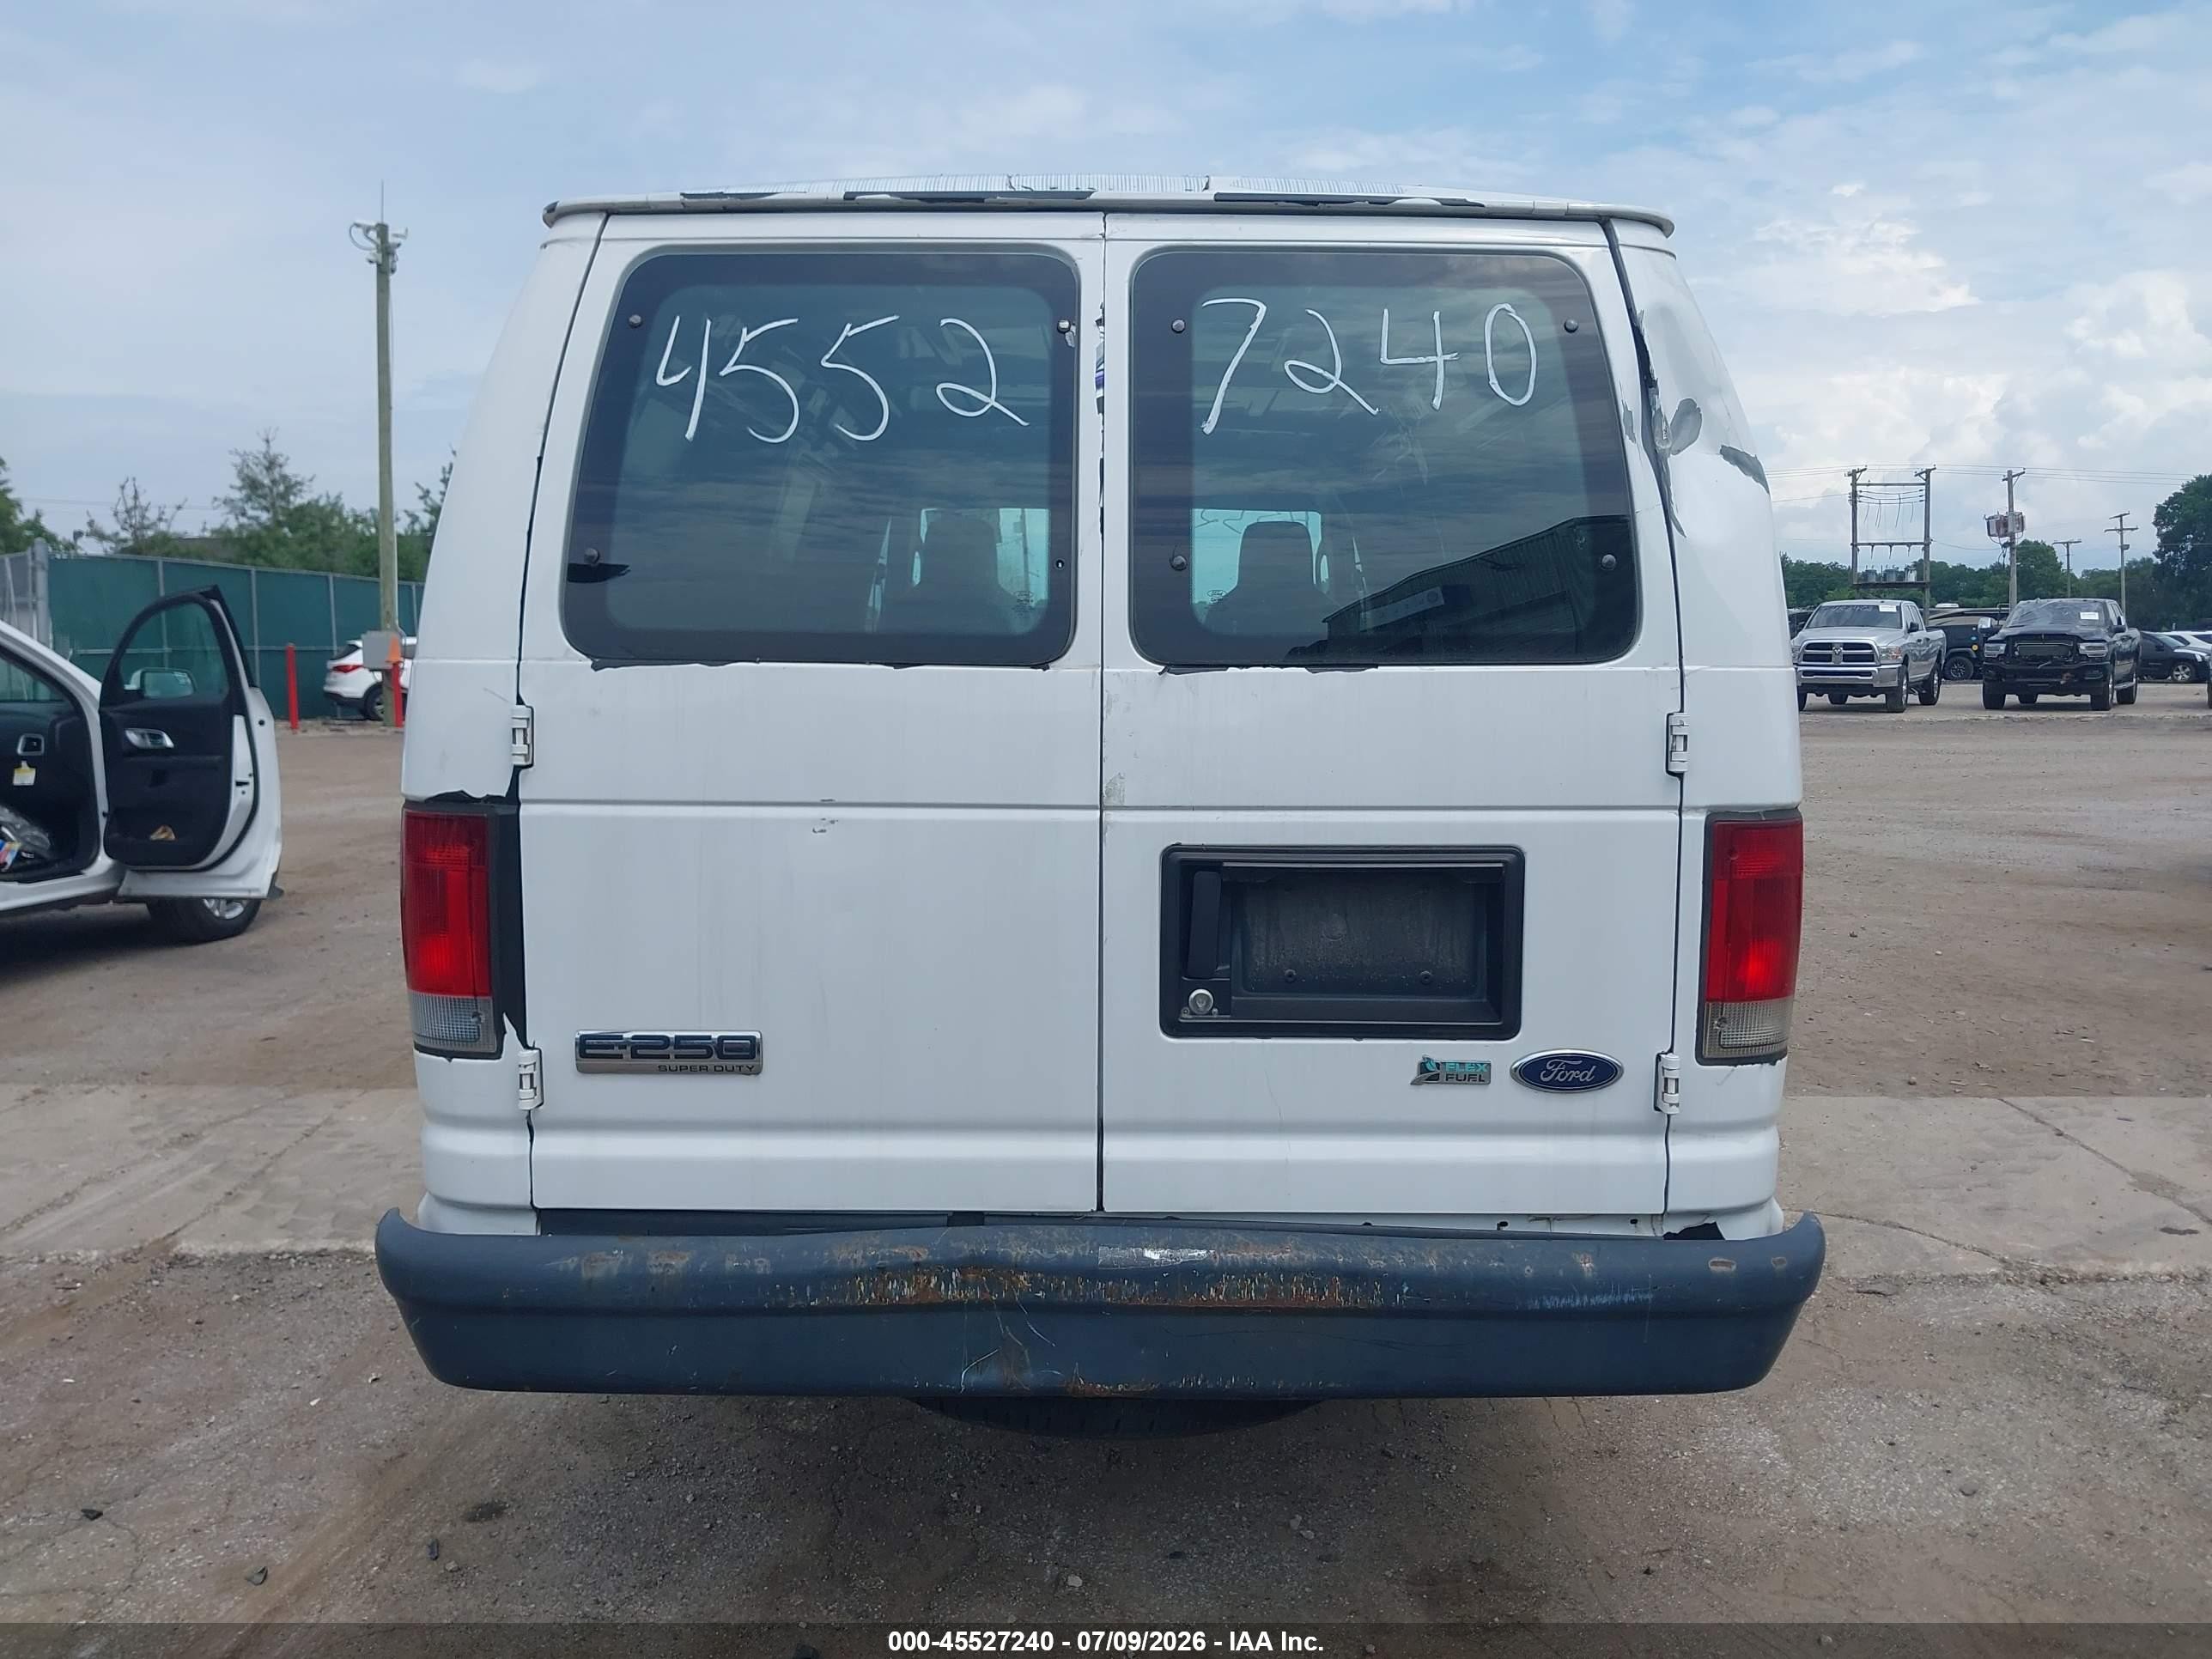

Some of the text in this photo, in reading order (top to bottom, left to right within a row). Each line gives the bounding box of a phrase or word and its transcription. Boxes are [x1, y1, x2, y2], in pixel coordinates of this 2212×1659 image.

[1200, 297, 1538, 435] 7240
[655, 314, 1030, 445] 4552
[579, 1033, 757, 1060] E-250
[658, 1064, 757, 1073] SUPER DUTY
[1445, 1062, 1489, 1073] FLEX
[1445, 1073, 1486, 1083] FUEL
[1540, 1059, 1597, 1083] Ford
